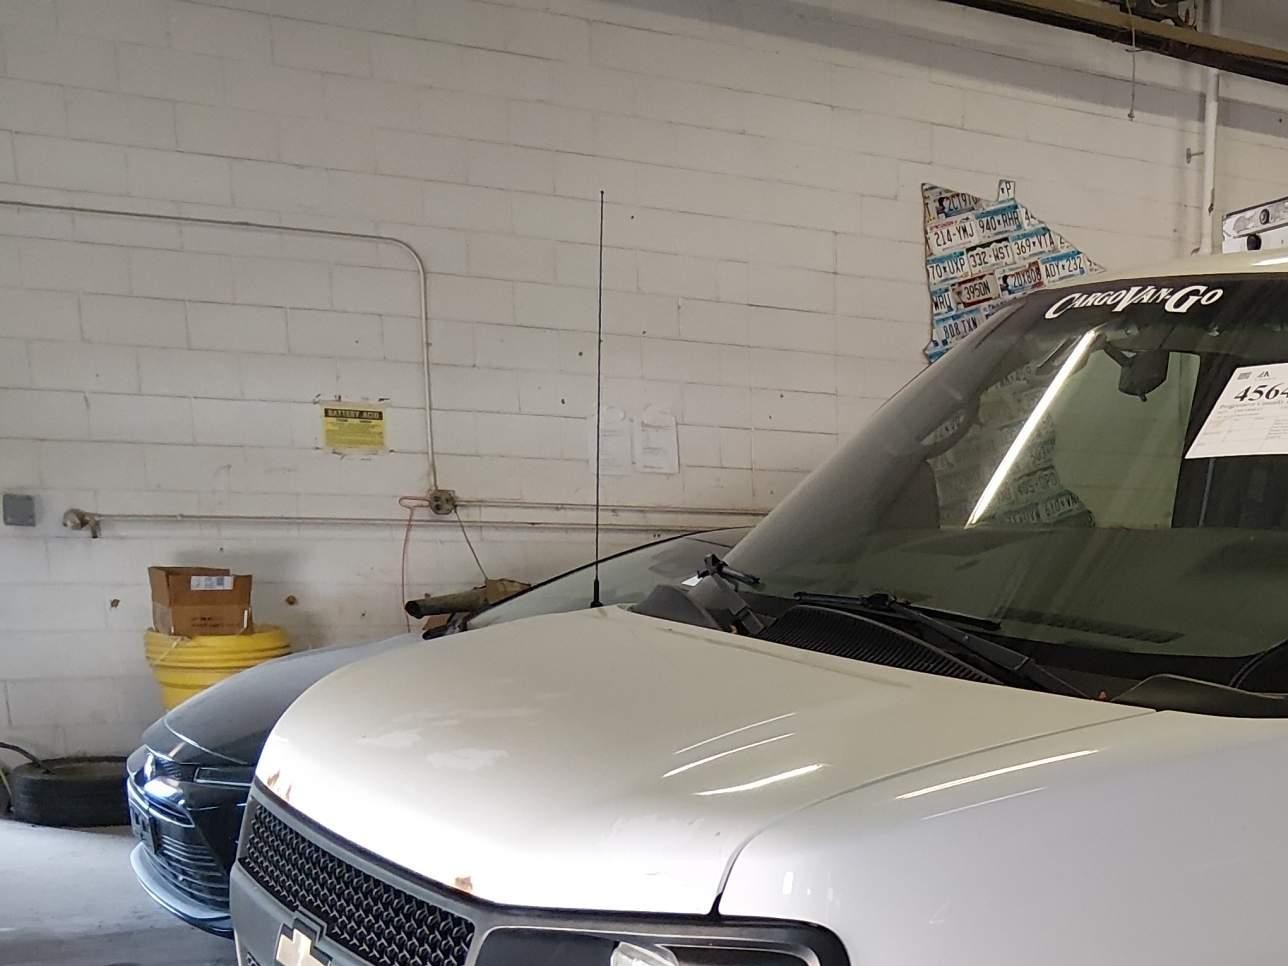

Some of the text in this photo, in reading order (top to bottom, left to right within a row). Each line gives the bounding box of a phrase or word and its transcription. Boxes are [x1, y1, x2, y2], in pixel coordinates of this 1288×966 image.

[979, 216, 996, 233] 940
[934, 221, 974, 247] 214-YMJ
[1014, 239, 1031, 256] 369
